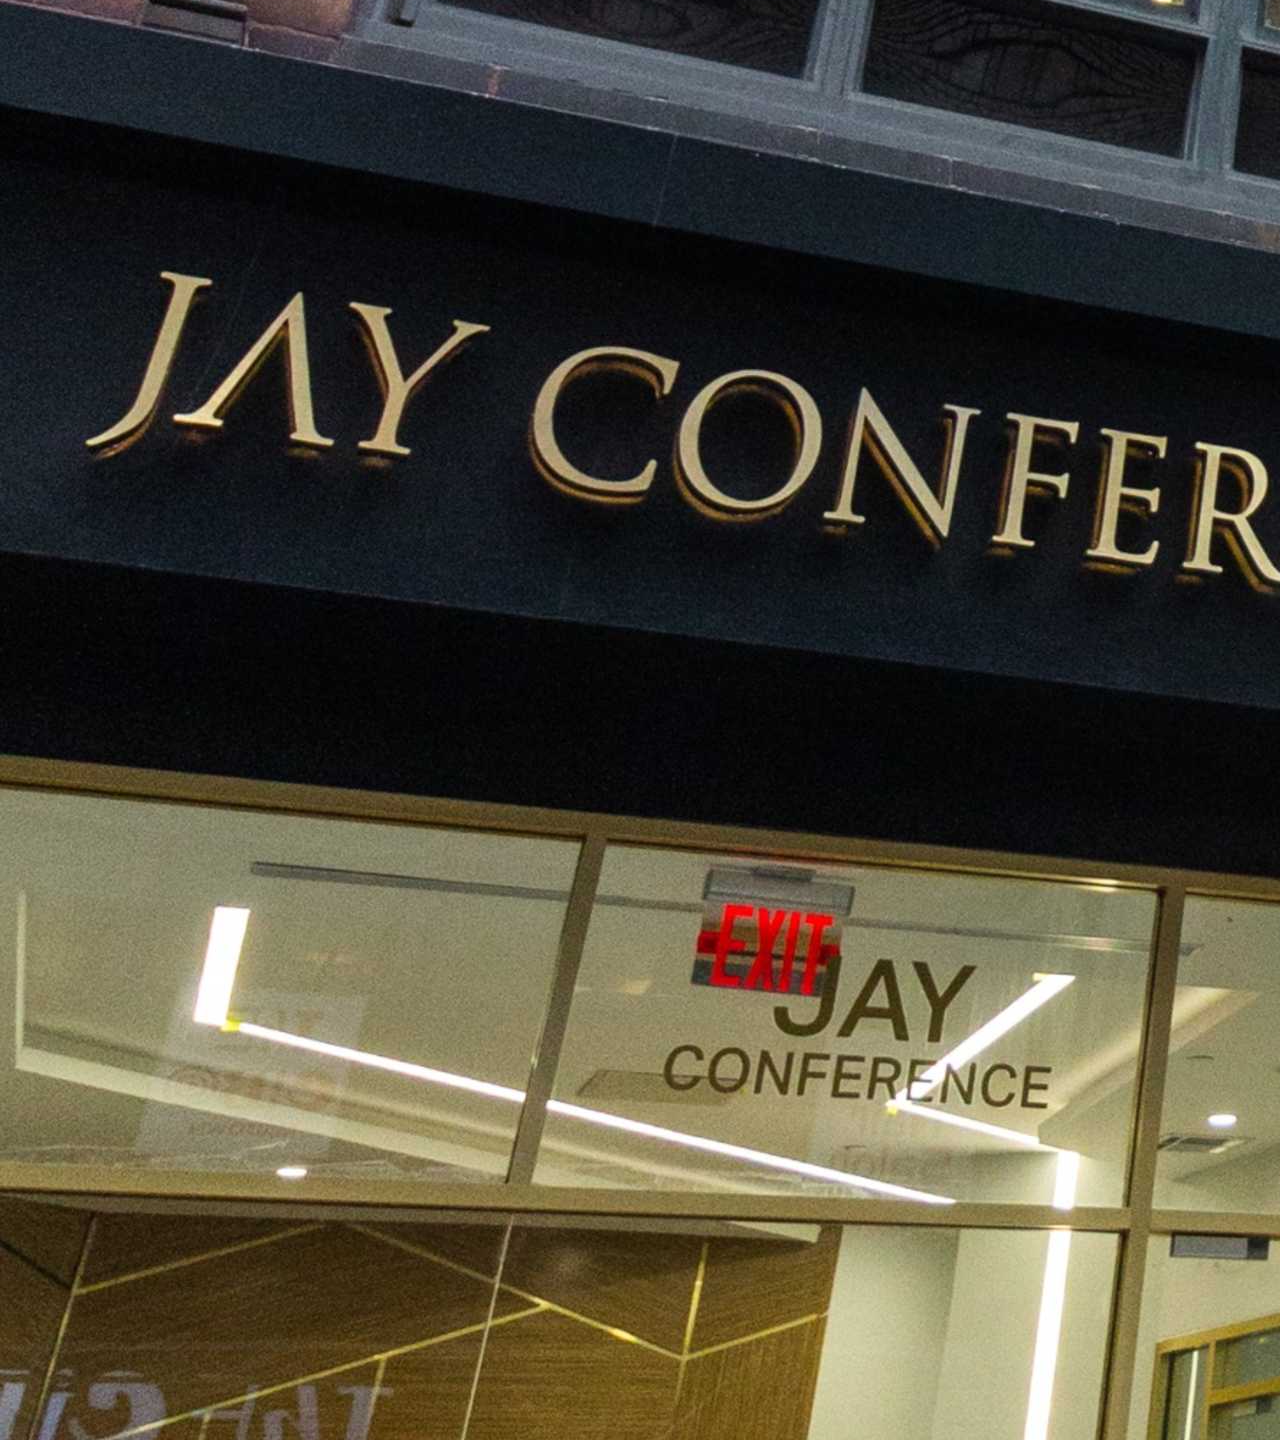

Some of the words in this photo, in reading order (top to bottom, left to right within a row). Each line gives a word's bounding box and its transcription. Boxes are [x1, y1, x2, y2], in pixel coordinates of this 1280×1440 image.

[86, 271, 491, 456] JAY
[709, 903, 834, 997] EXIT
[773, 957, 977, 1043] JAY
[663, 1044, 1053, 1110] CONFERENCE
